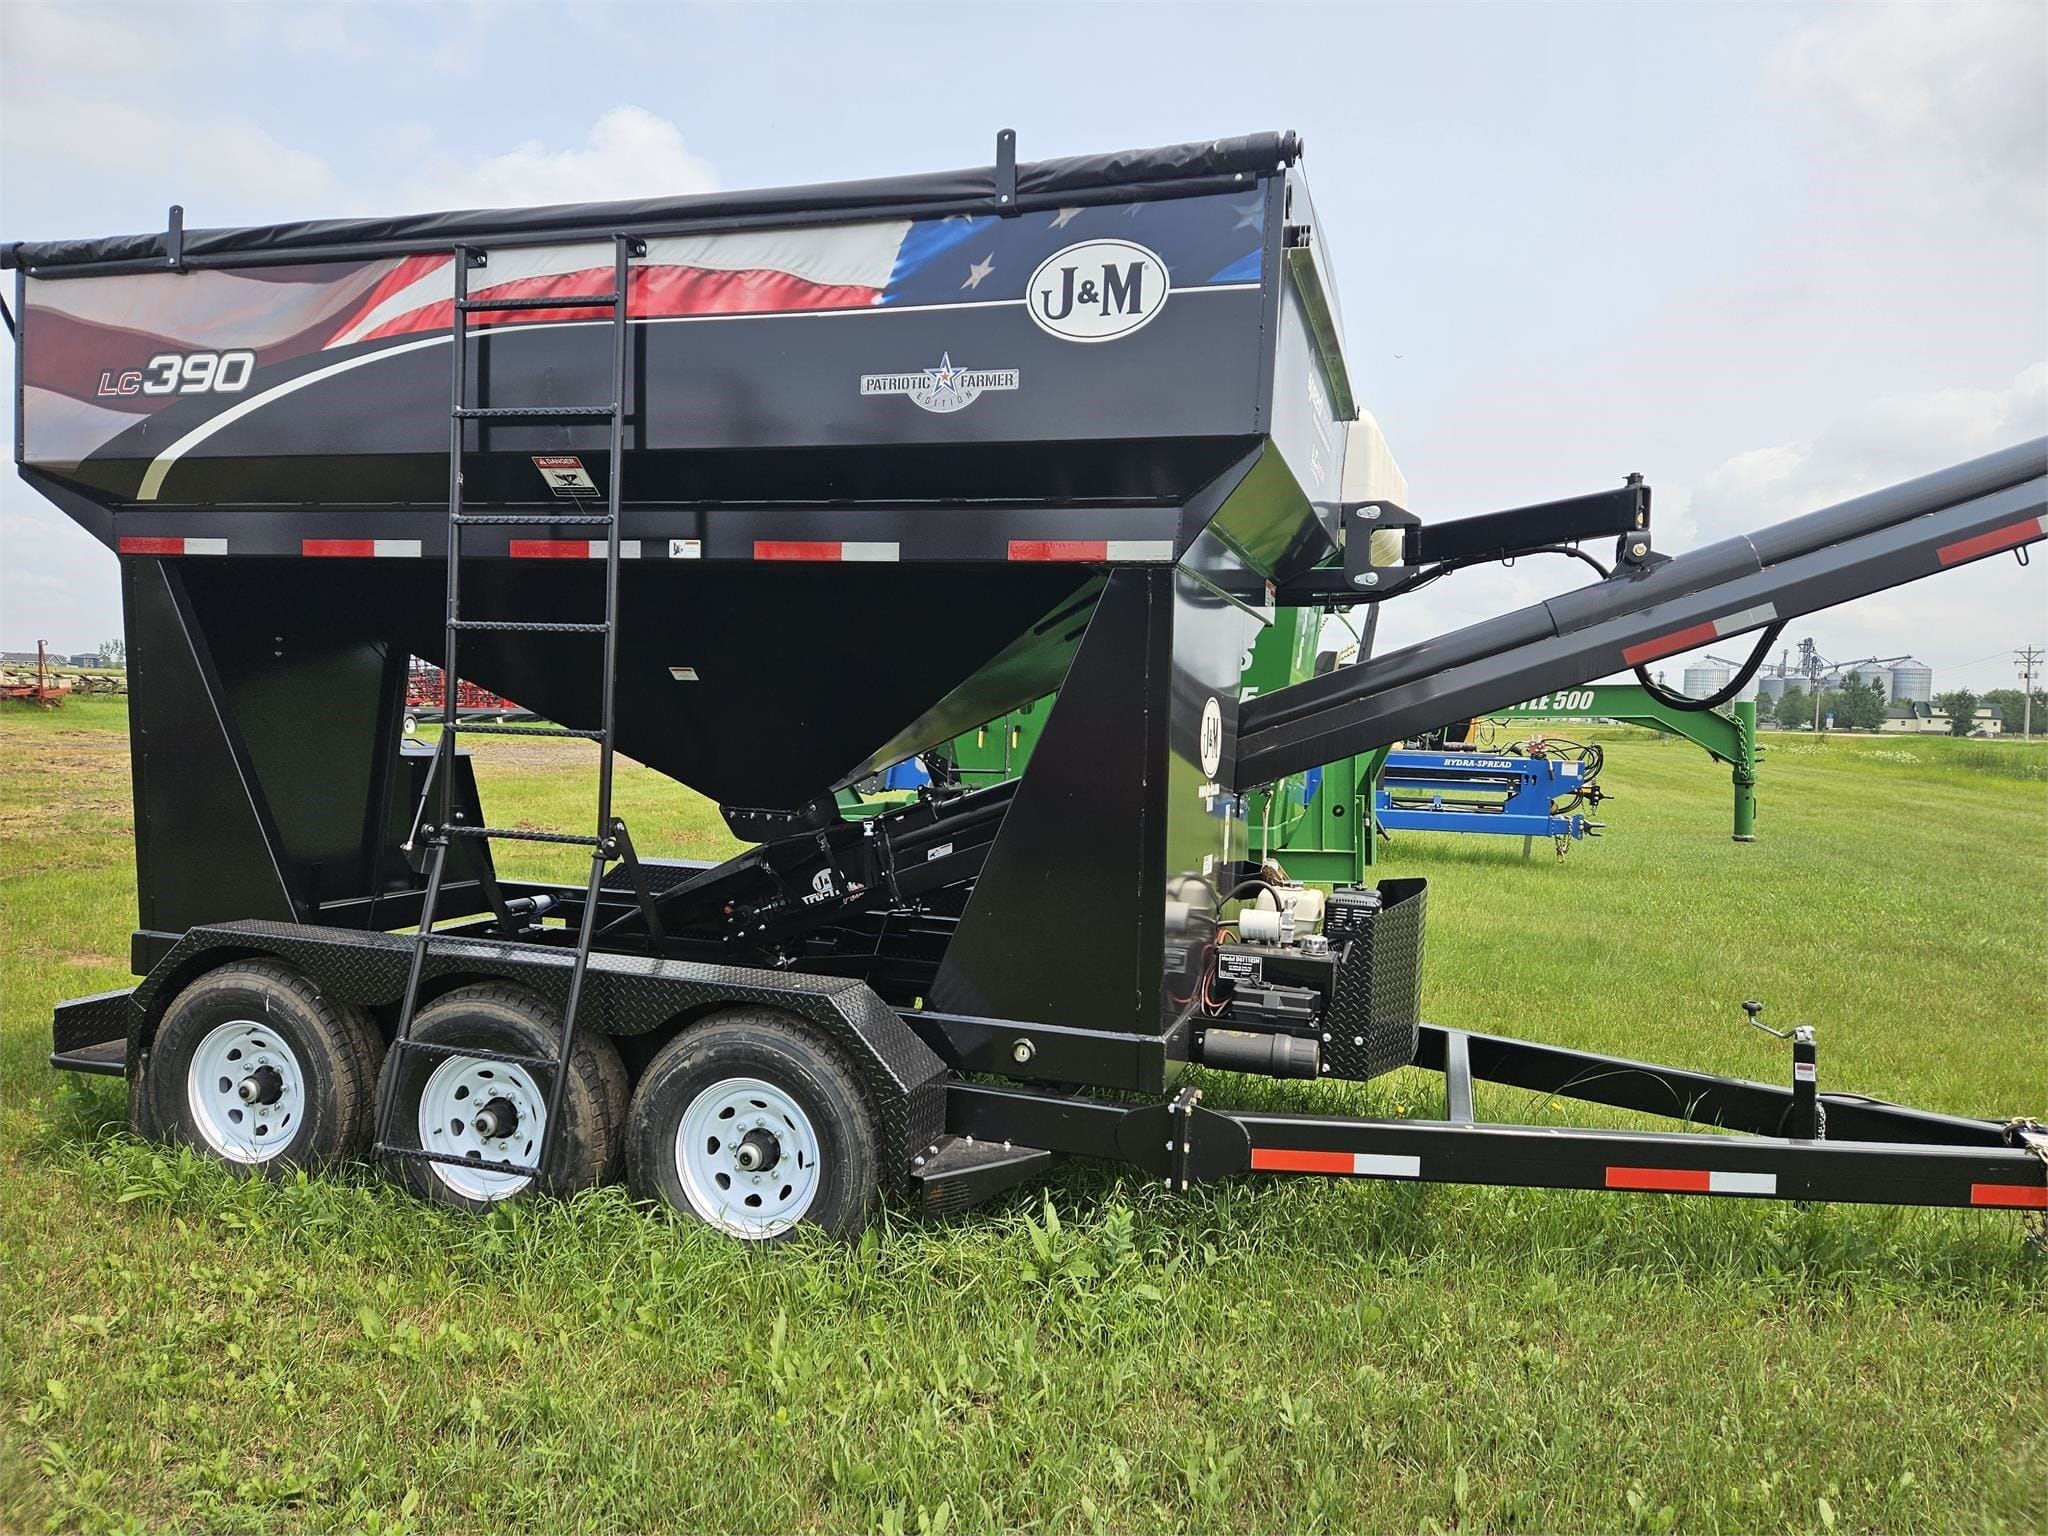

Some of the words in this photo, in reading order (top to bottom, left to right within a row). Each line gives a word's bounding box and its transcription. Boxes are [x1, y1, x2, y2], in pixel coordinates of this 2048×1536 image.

[1041, 261, 1146, 320] J&M
[866, 376, 931, 391] PATRIOTIC
[961, 373, 1014, 388] FARMER
[916, 391, 973, 407] EDITION
[1552, 690, 1595, 710] 500
[1203, 716, 1219, 759] J&M
[1443, 758, 1512, 769] HYDRA-SPREAD
